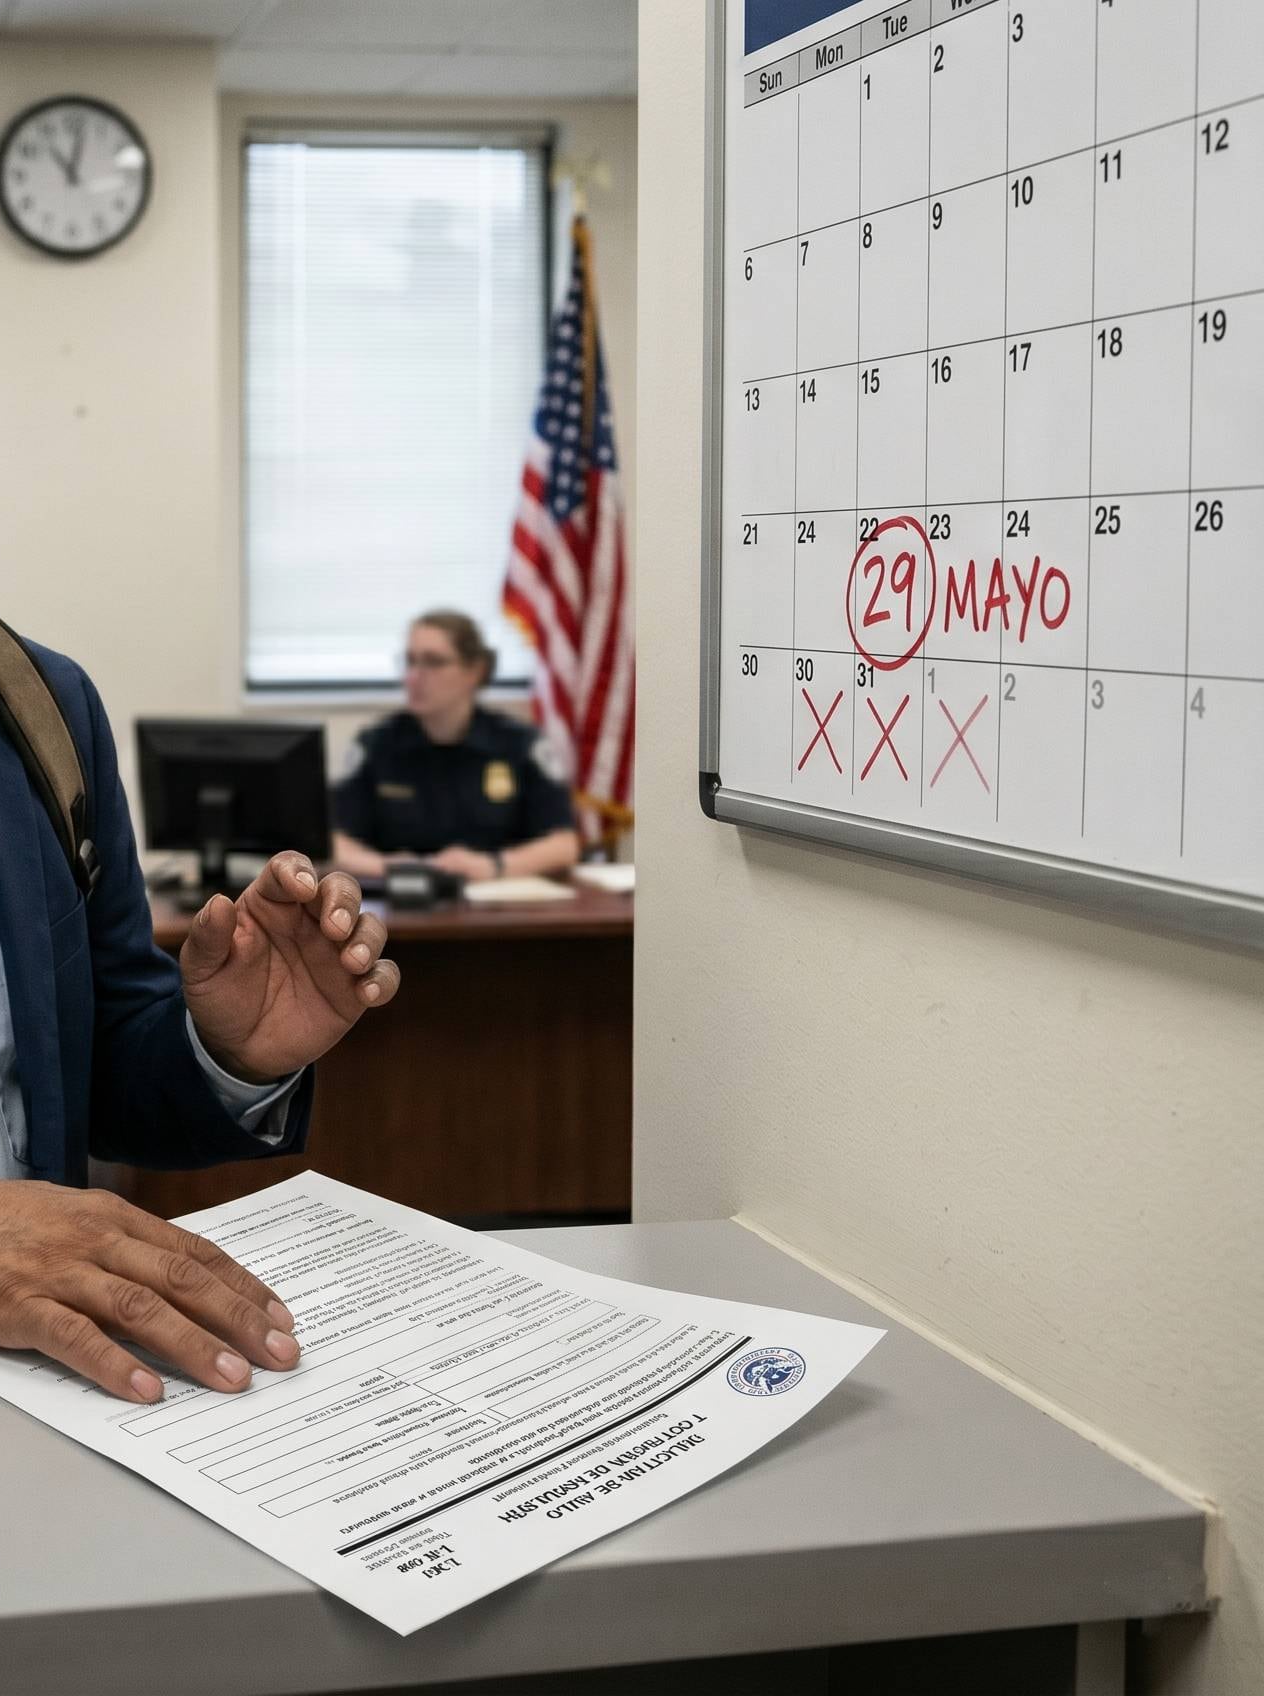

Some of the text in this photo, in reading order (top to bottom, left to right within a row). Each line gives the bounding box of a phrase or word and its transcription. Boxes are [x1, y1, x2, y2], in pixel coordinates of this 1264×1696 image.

[758, 12, 909, 95] Sun Mon Tue
[863, 13, 1024, 101] 1 2 3
[744, 118, 1230, 281] 6 7 8 9 10 11 12
[744, 309, 1227, 412] 13 14 15 16 17 18 19
[742, 499, 1224, 546] 21 24 22 23 24 25 26
[863, 551, 1071, 642] 29 MAYO
[741, 653, 1206, 720] 30 30 31 1 2 3 4
